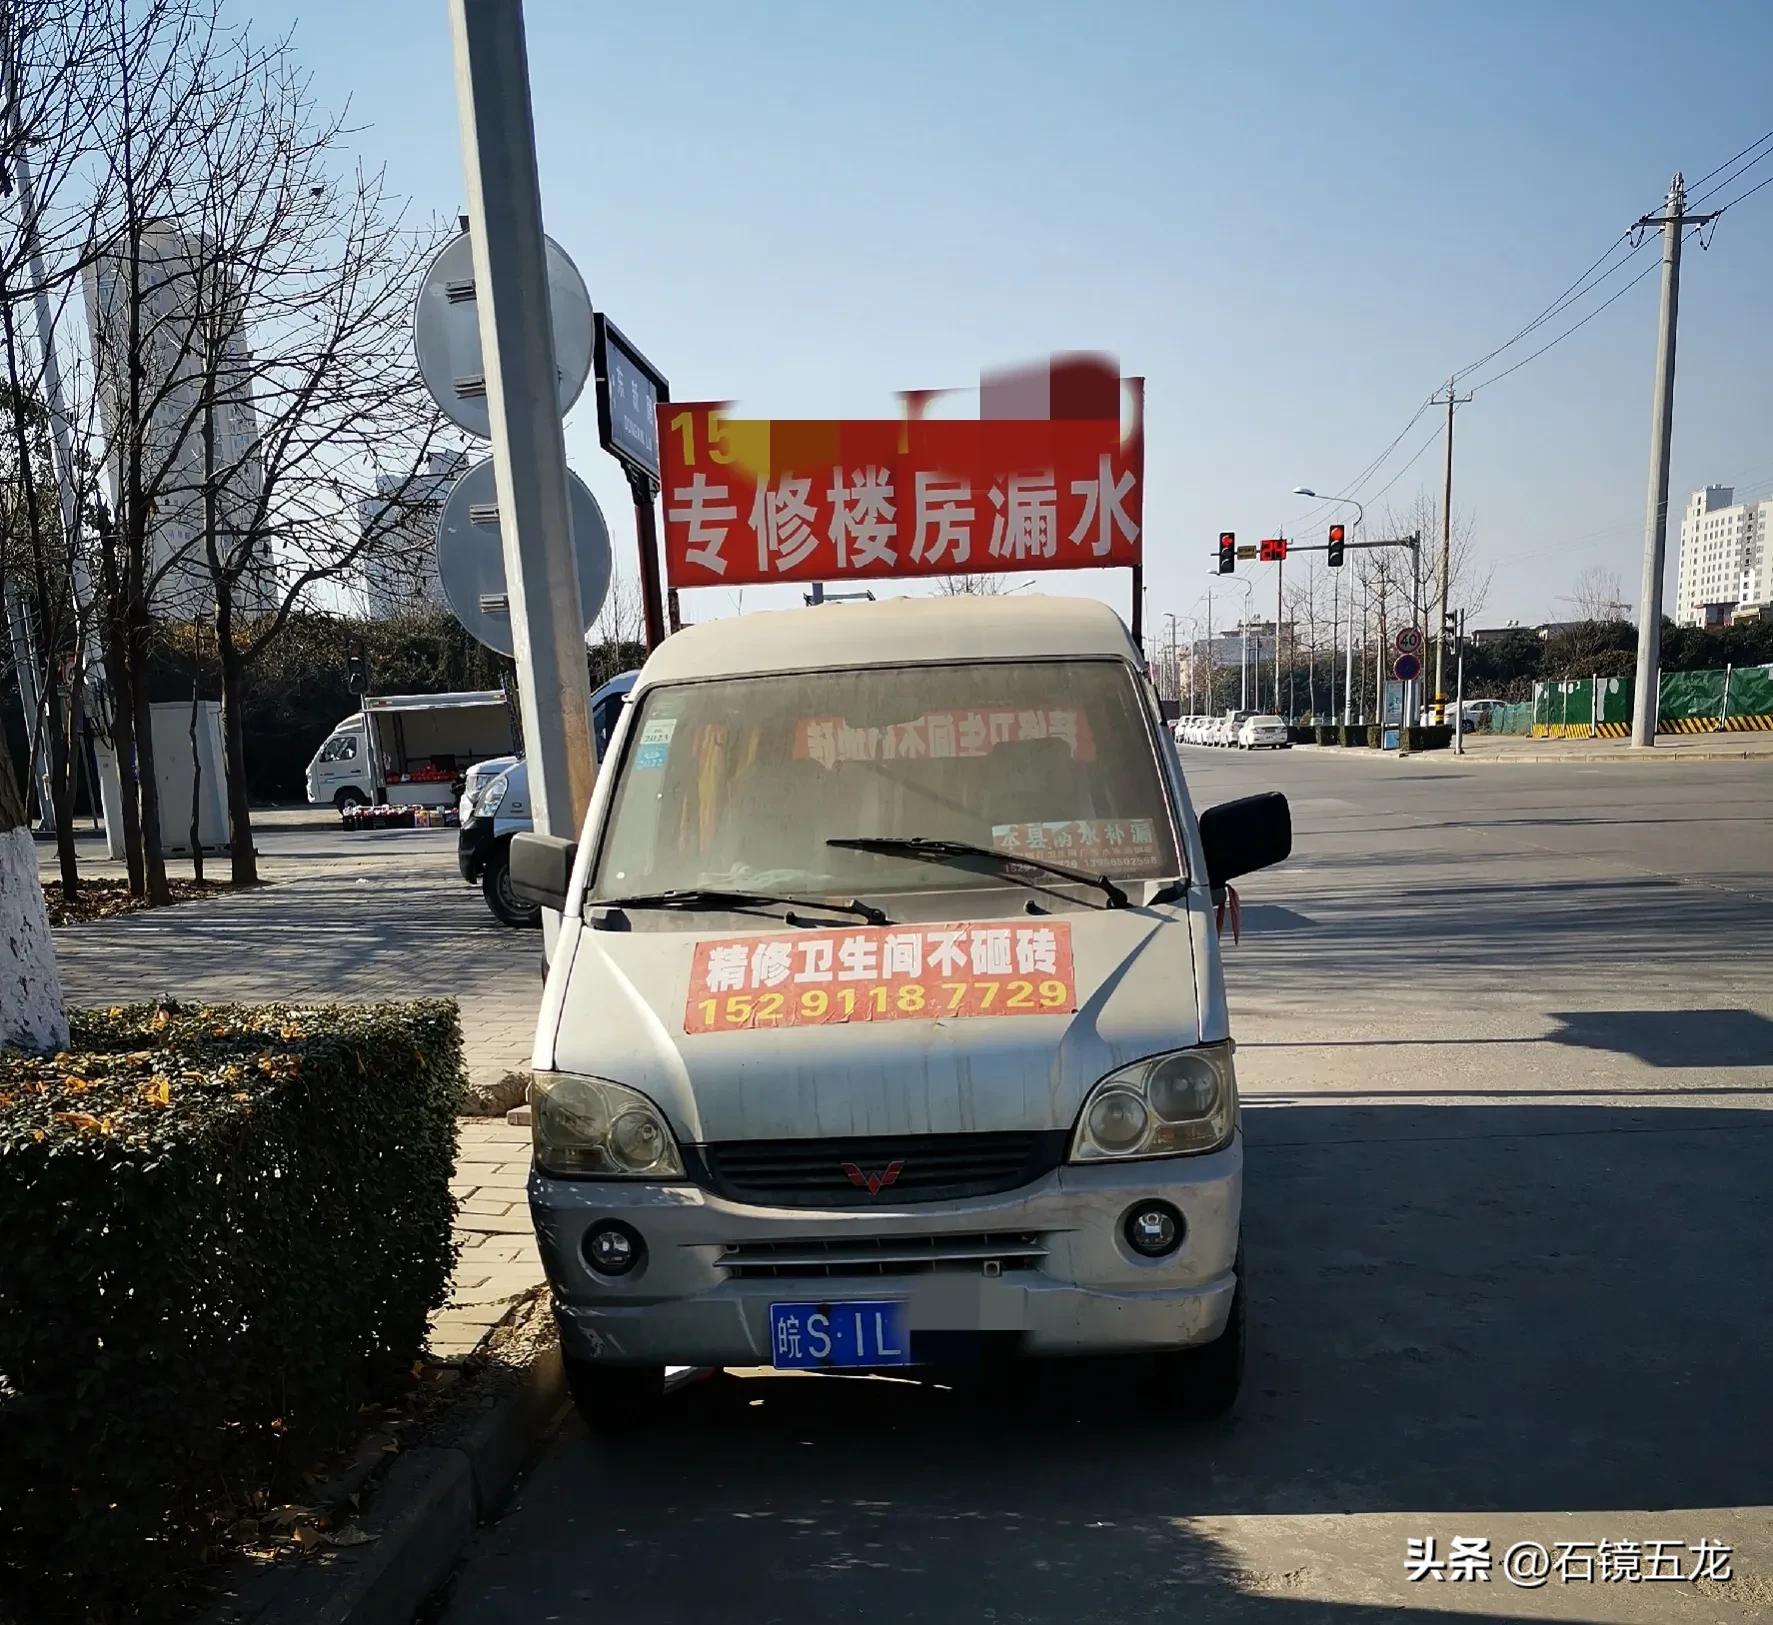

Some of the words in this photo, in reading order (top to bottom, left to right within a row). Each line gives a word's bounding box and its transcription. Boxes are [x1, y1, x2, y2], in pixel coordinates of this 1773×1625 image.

[667, 453, 1140, 575] 专修楼房漏水
[1399, 633, 1418, 648] 40
[705, 928, 1058, 993] 精修卫生间不砸砖
[697, 992, 785, 1026] 152
[800, 984, 926, 1020] 9118
[941, 980, 1069, 1010] 7729
